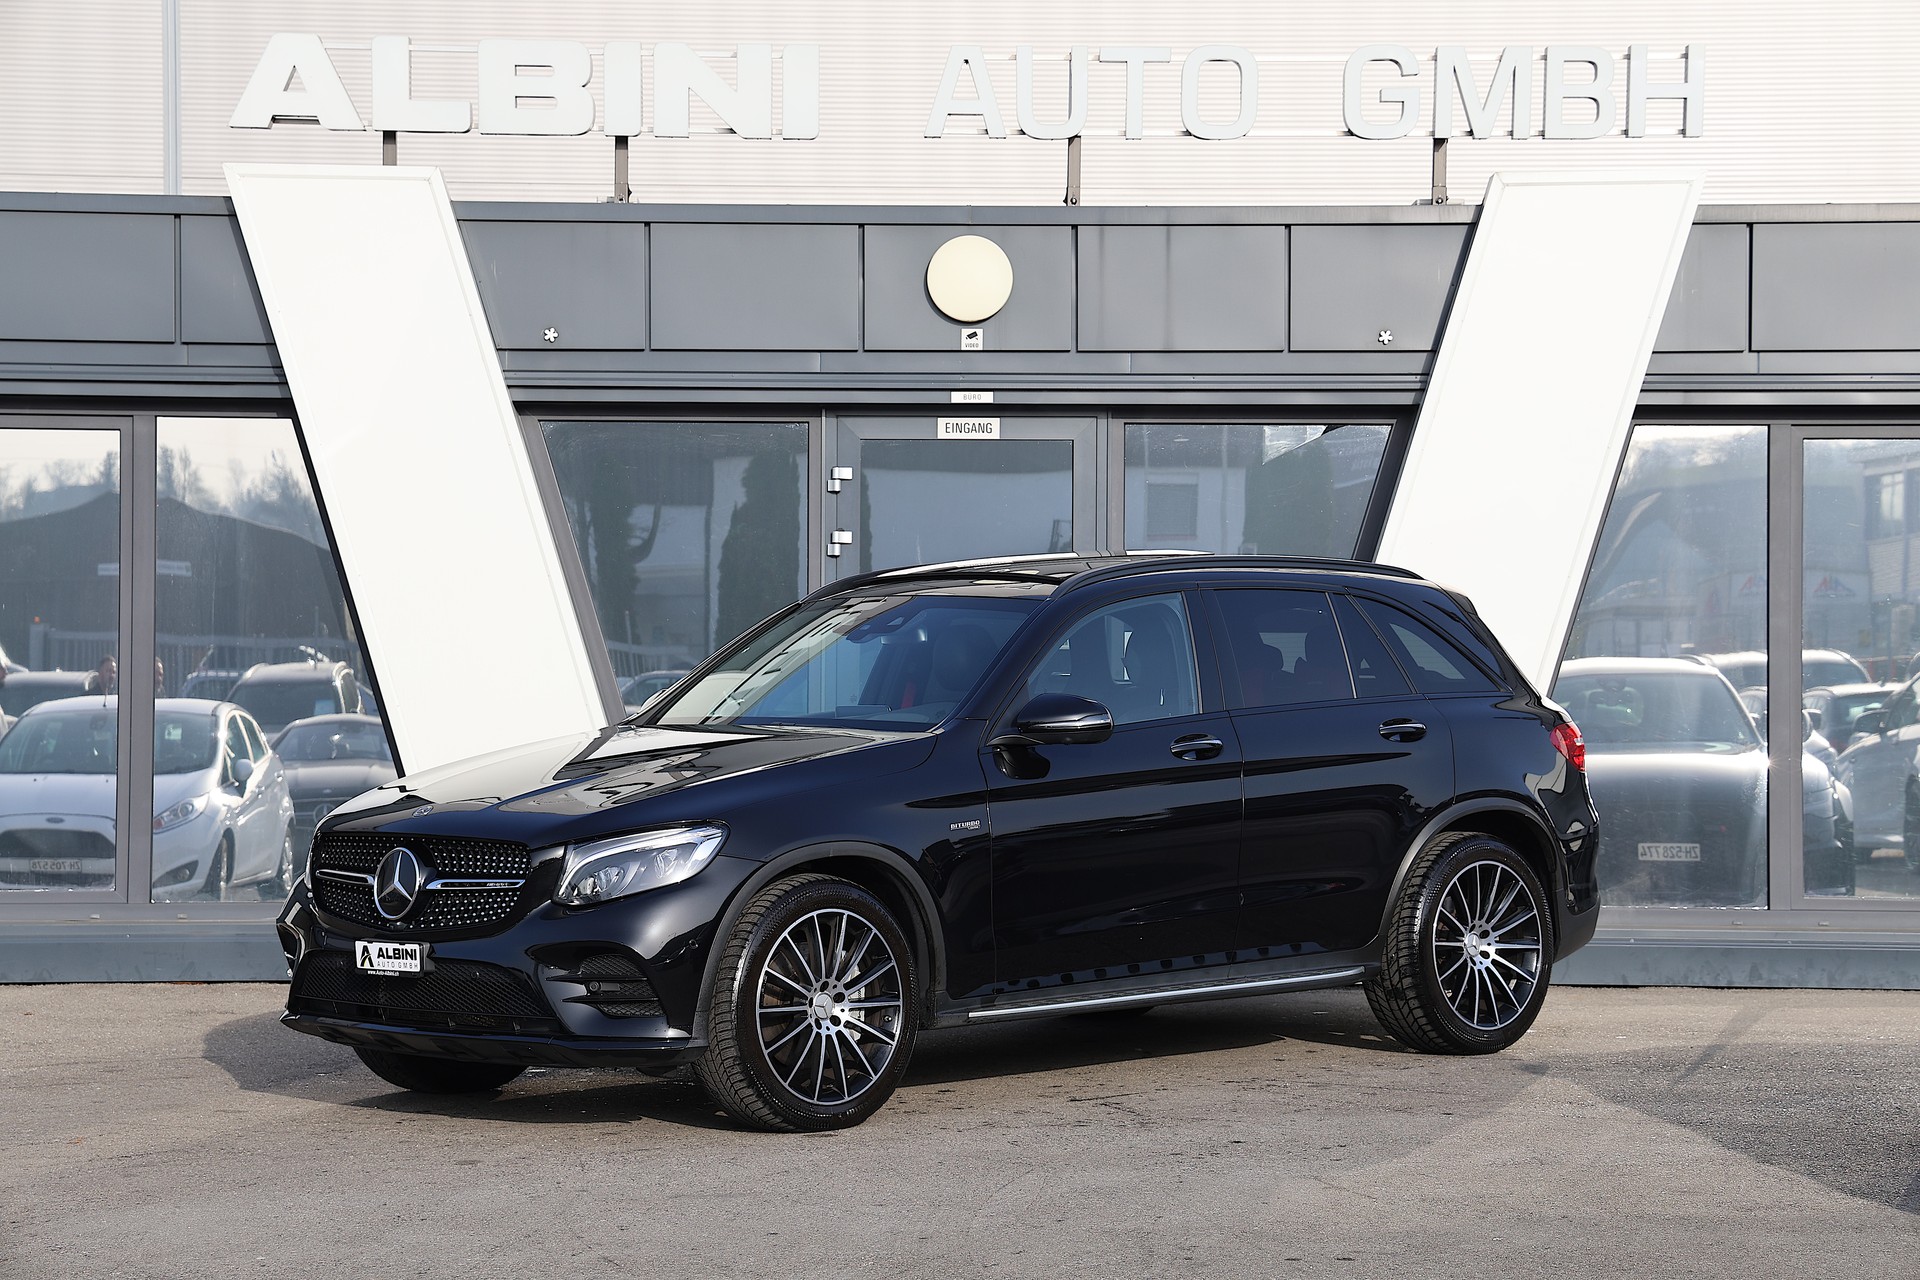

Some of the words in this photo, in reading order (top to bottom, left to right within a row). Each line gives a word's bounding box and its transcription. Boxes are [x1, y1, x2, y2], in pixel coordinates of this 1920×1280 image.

[229, 33, 820, 140] ALBINI
[923, 44, 1260, 140] AUTO
[1341, 45, 1706, 139] GMBH
[963, 393, 982, 401] BÜRO
[945, 422, 993, 434] EINGANG
[377, 947, 417, 960] ALBINI
[377, 961, 395, 969] AUTO
